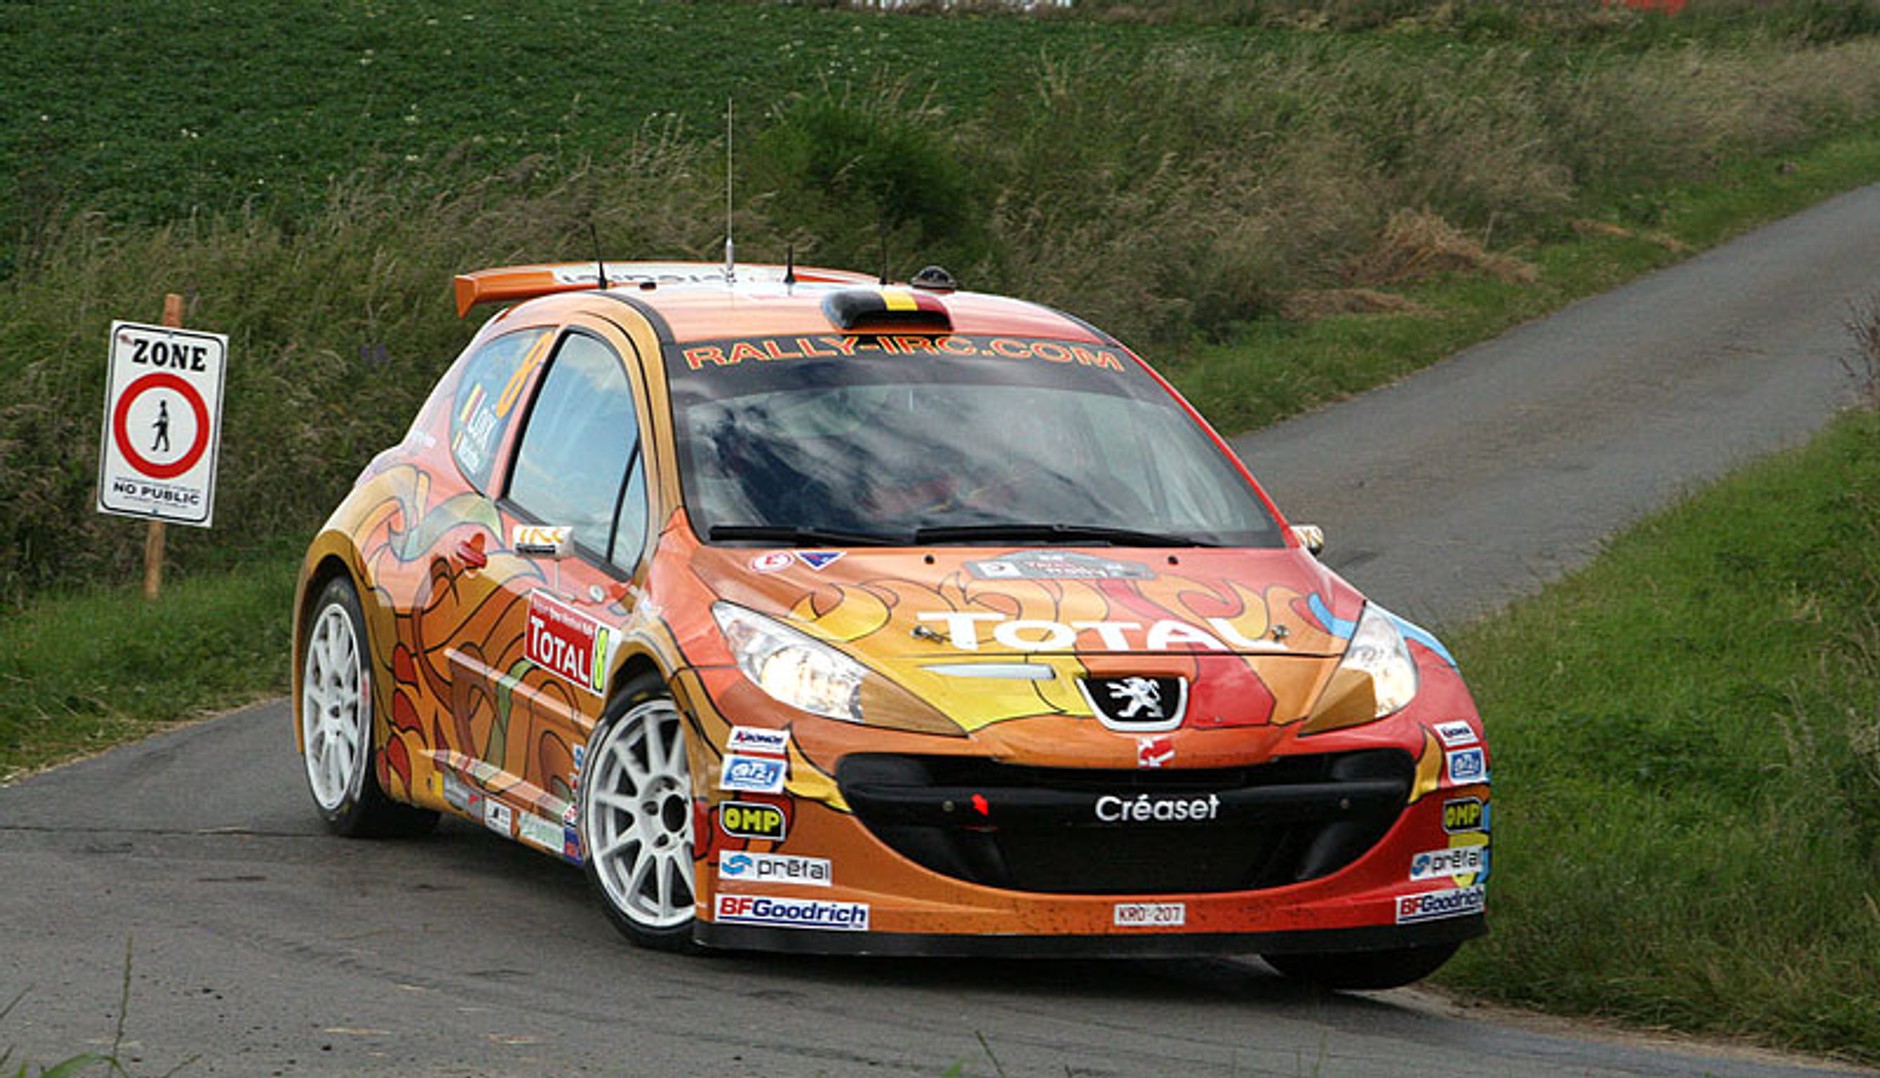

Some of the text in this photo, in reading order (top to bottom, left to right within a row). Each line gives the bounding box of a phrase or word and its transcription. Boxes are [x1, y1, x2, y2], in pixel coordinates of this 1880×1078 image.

[132, 338, 208, 372] ZONE
[683, 336, 1125, 371] RALLY-IRC.COM
[495, 331, 555, 418] 8
[113, 482, 138, 494] NO
[141, 486, 201, 505] PUBLIC
[915, 610, 1290, 651] TOTAL
[531, 615, 590, 684] TOTAL
[594, 628, 609, 691] 8
[724, 807, 781, 833] OMP
[1095, 794, 1221, 821] Créaset
[1445, 803, 1481, 827] OMP
[719, 897, 866, 922] BFGoodrich
[1400, 887, 1484, 915] BFGoodrich
